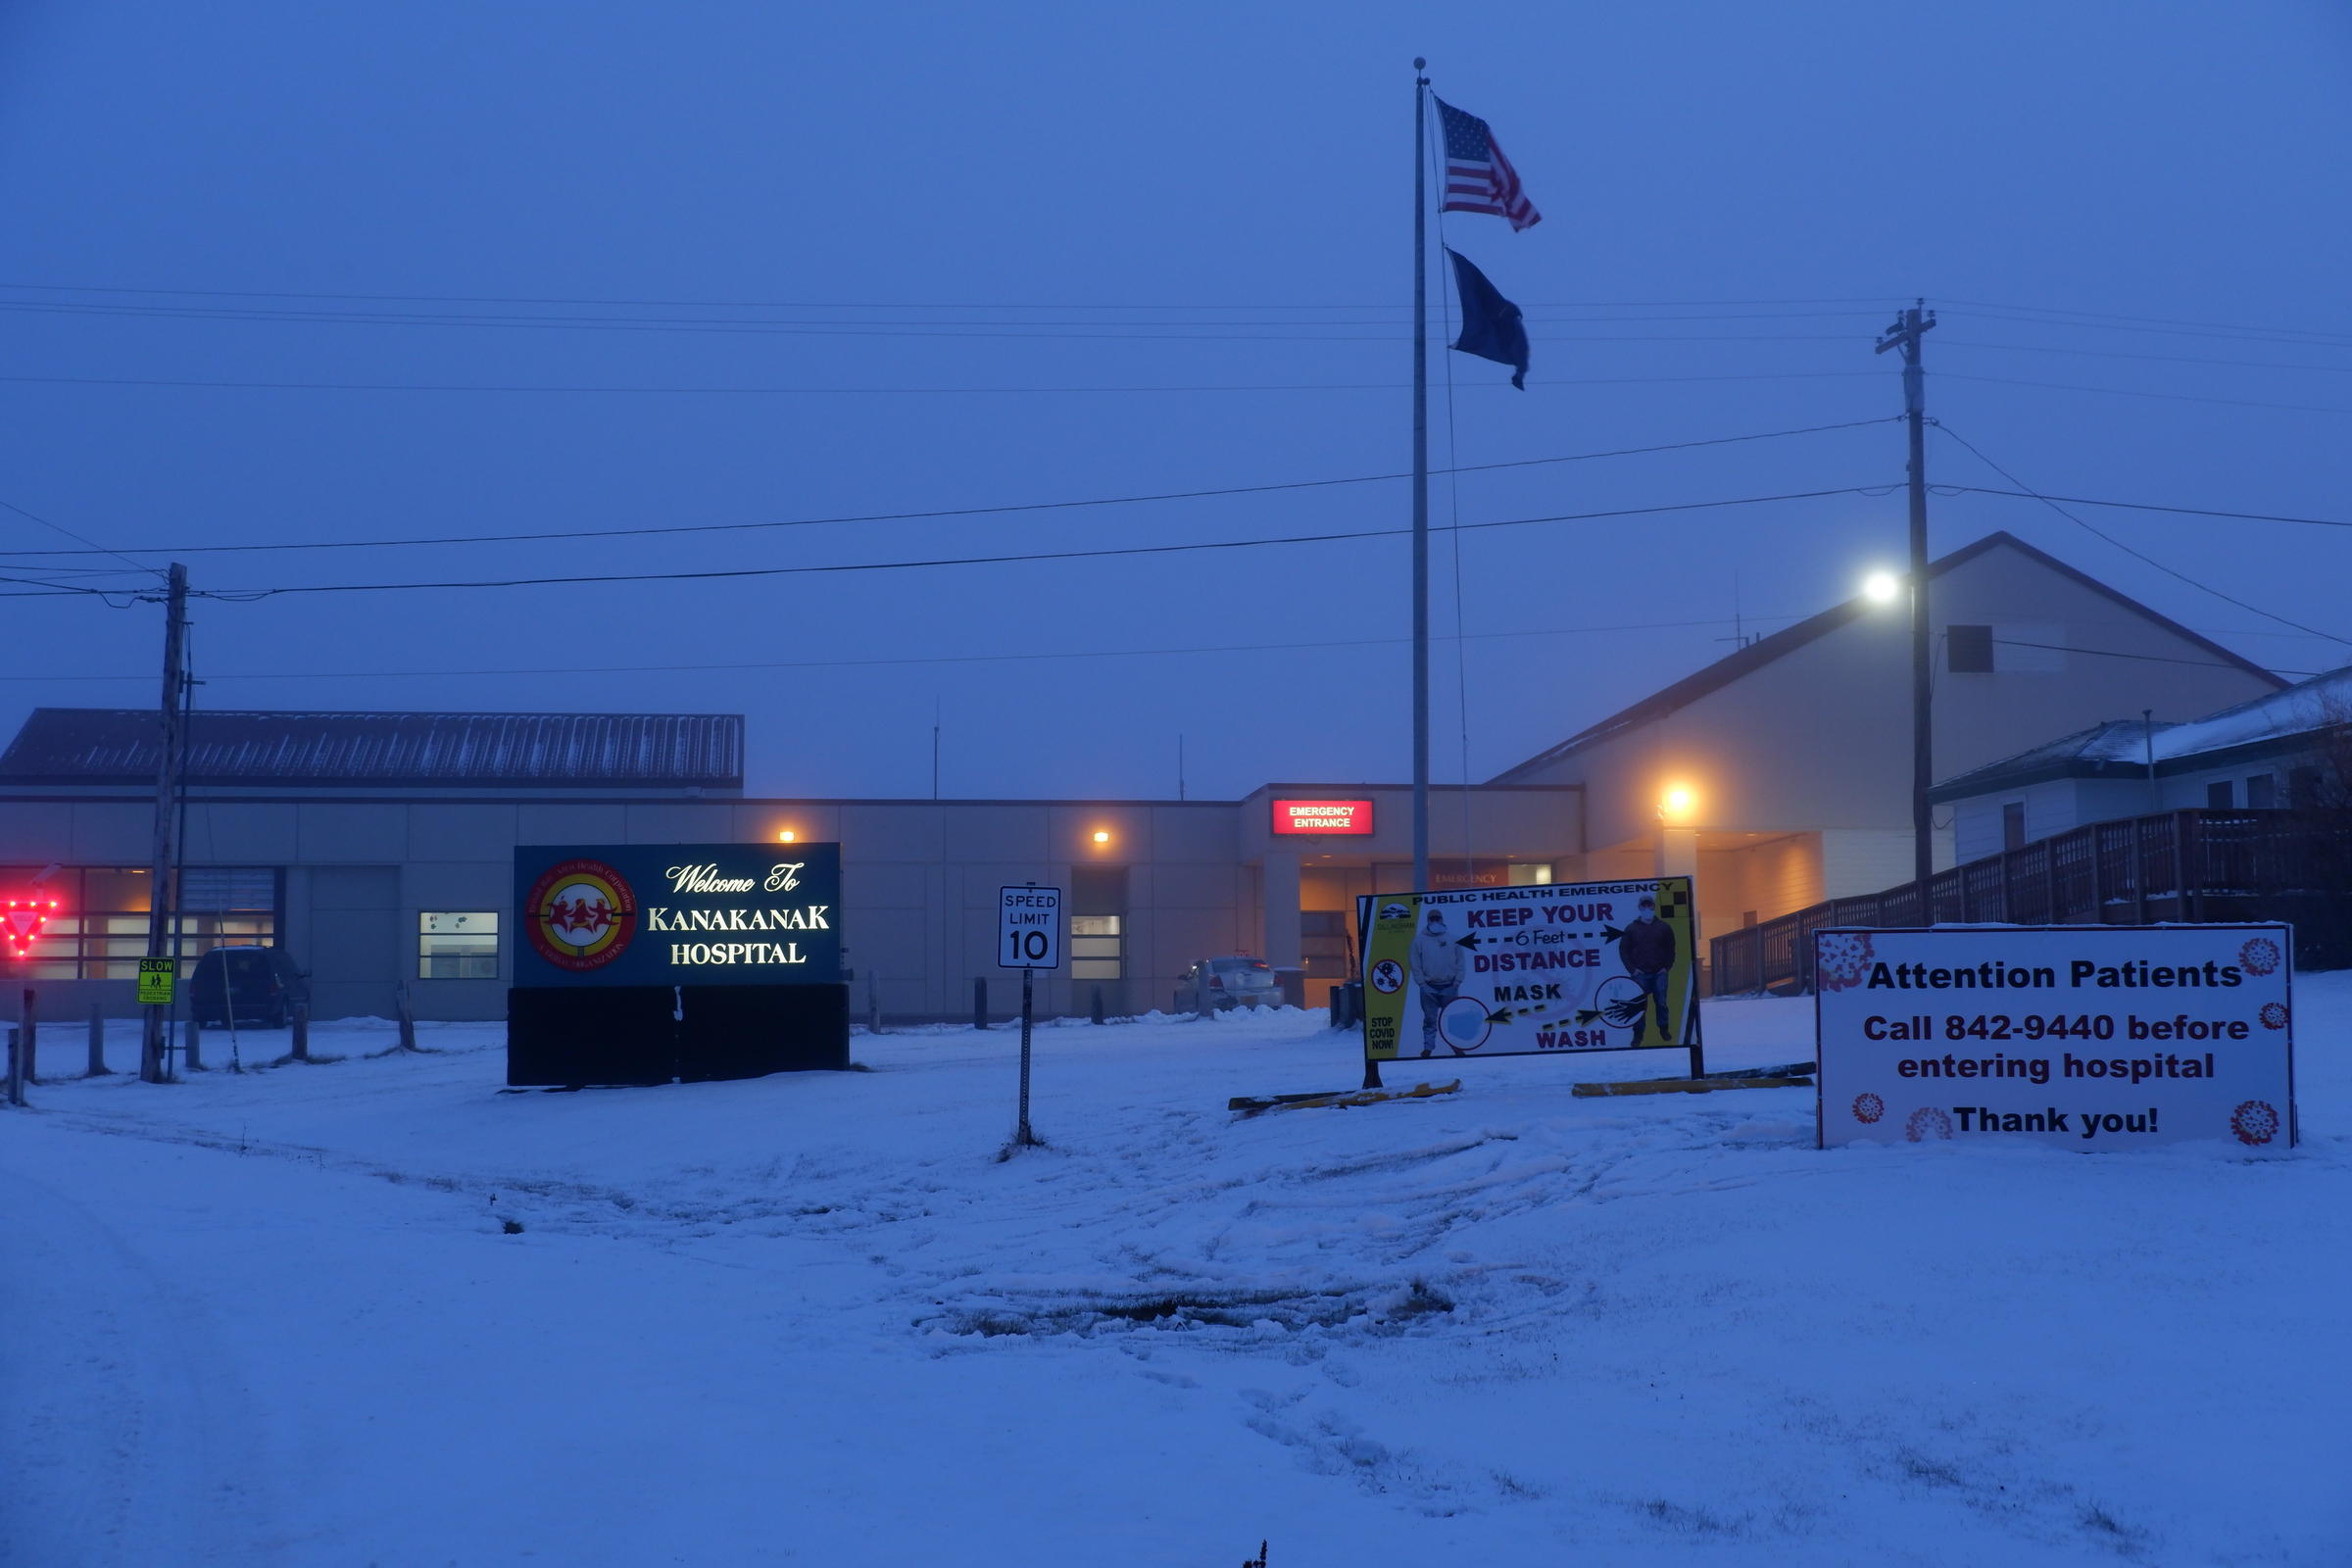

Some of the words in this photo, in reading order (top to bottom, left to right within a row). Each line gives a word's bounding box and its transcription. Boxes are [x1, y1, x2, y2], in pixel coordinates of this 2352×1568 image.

[1289, 807, 1355, 816] EMERGENCY
[1294, 817, 1350, 828] ENTRANCE
[665, 862, 756, 894] Welcome
[763, 861, 805, 892] To
[1004, 895, 1056, 908] SPEED
[1412, 892, 1477, 906] PUBLIC
[1482, 888, 1553, 902] HEALTH
[1561, 882, 1673, 897] EMERGENCY
[648, 906, 830, 931] KANAKANAK
[1009, 912, 1051, 926] LIMIT
[1467, 907, 1534, 929] KEEP
[1541, 903, 1614, 924] YOUR
[1009, 930, 1049, 960] 10
[1515, 930, 1530, 947] 6
[1533, 929, 1565, 945] Feet
[671, 942, 807, 965] HOSPITAL
[1473, 949, 1601, 973] DISTANCE
[140, 960, 173, 971] SLOW
[1867, 960, 2055, 990] Attention
[2071, 959, 2242, 989] Patients
[1494, 983, 1562, 1003] MASK
[1369, 1027, 1396, 1039] COVID
[1371, 1016, 1394, 1028] STOP
[1863, 1015, 1932, 1041] Call
[1945, 1014, 2115, 1041] 842-9440
[2128, 1014, 2250, 1041] before
[1536, 1030, 1606, 1050] WASH
[1897, 1053, 2050, 1085] entering
[2063, 1053, 2214, 1085] hospital
[1952, 1106, 2070, 1133] Thank
[2081, 1107, 2158, 1140] you!
